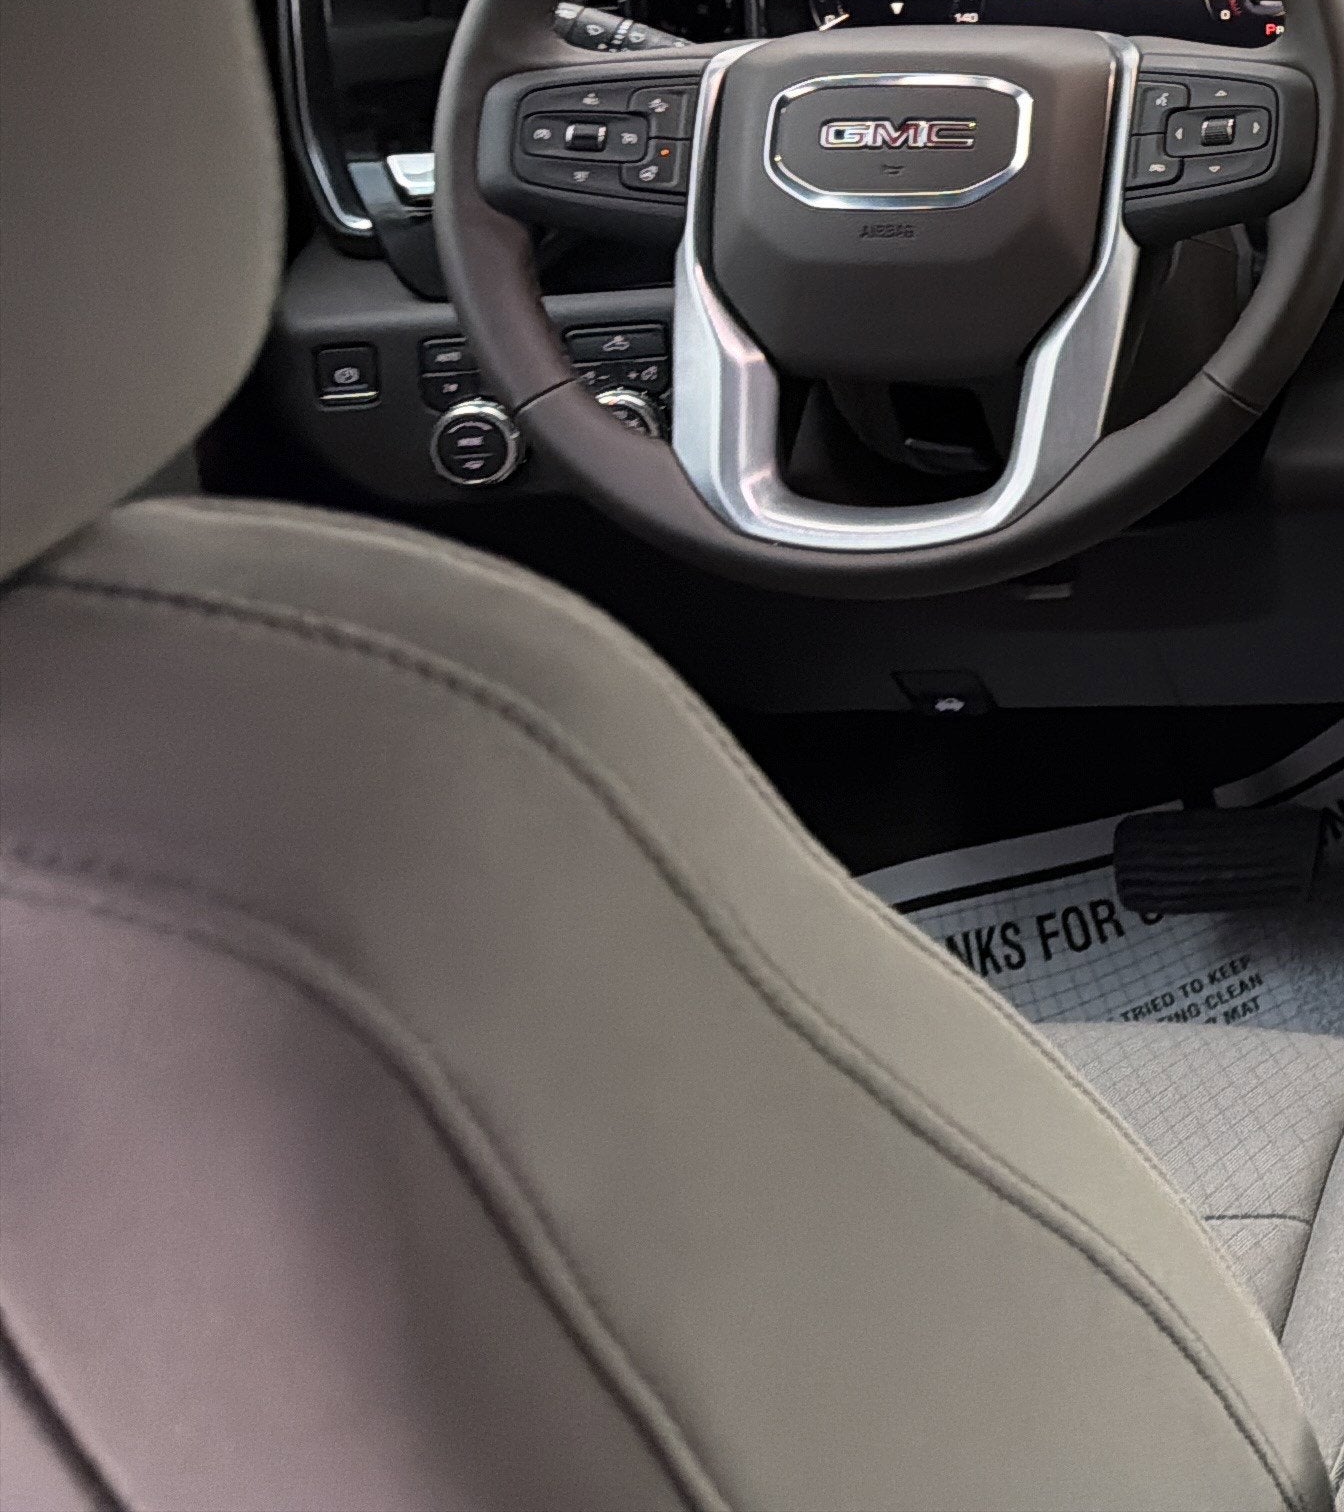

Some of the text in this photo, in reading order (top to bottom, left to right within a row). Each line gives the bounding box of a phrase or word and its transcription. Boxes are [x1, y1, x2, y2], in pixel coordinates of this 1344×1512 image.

[1264, 22, 1276, 36] P
[819, 117, 978, 150] GMC
[1036, 897, 1127, 962] FOR
[1120, 991, 1175, 1023] TRIED
[1178, 978, 1205, 999] TO
[1207, 954, 1252, 985] KEEP
[1205, 972, 1264, 1010] CLEAN
[1222, 994, 1262, 1025] MAT
